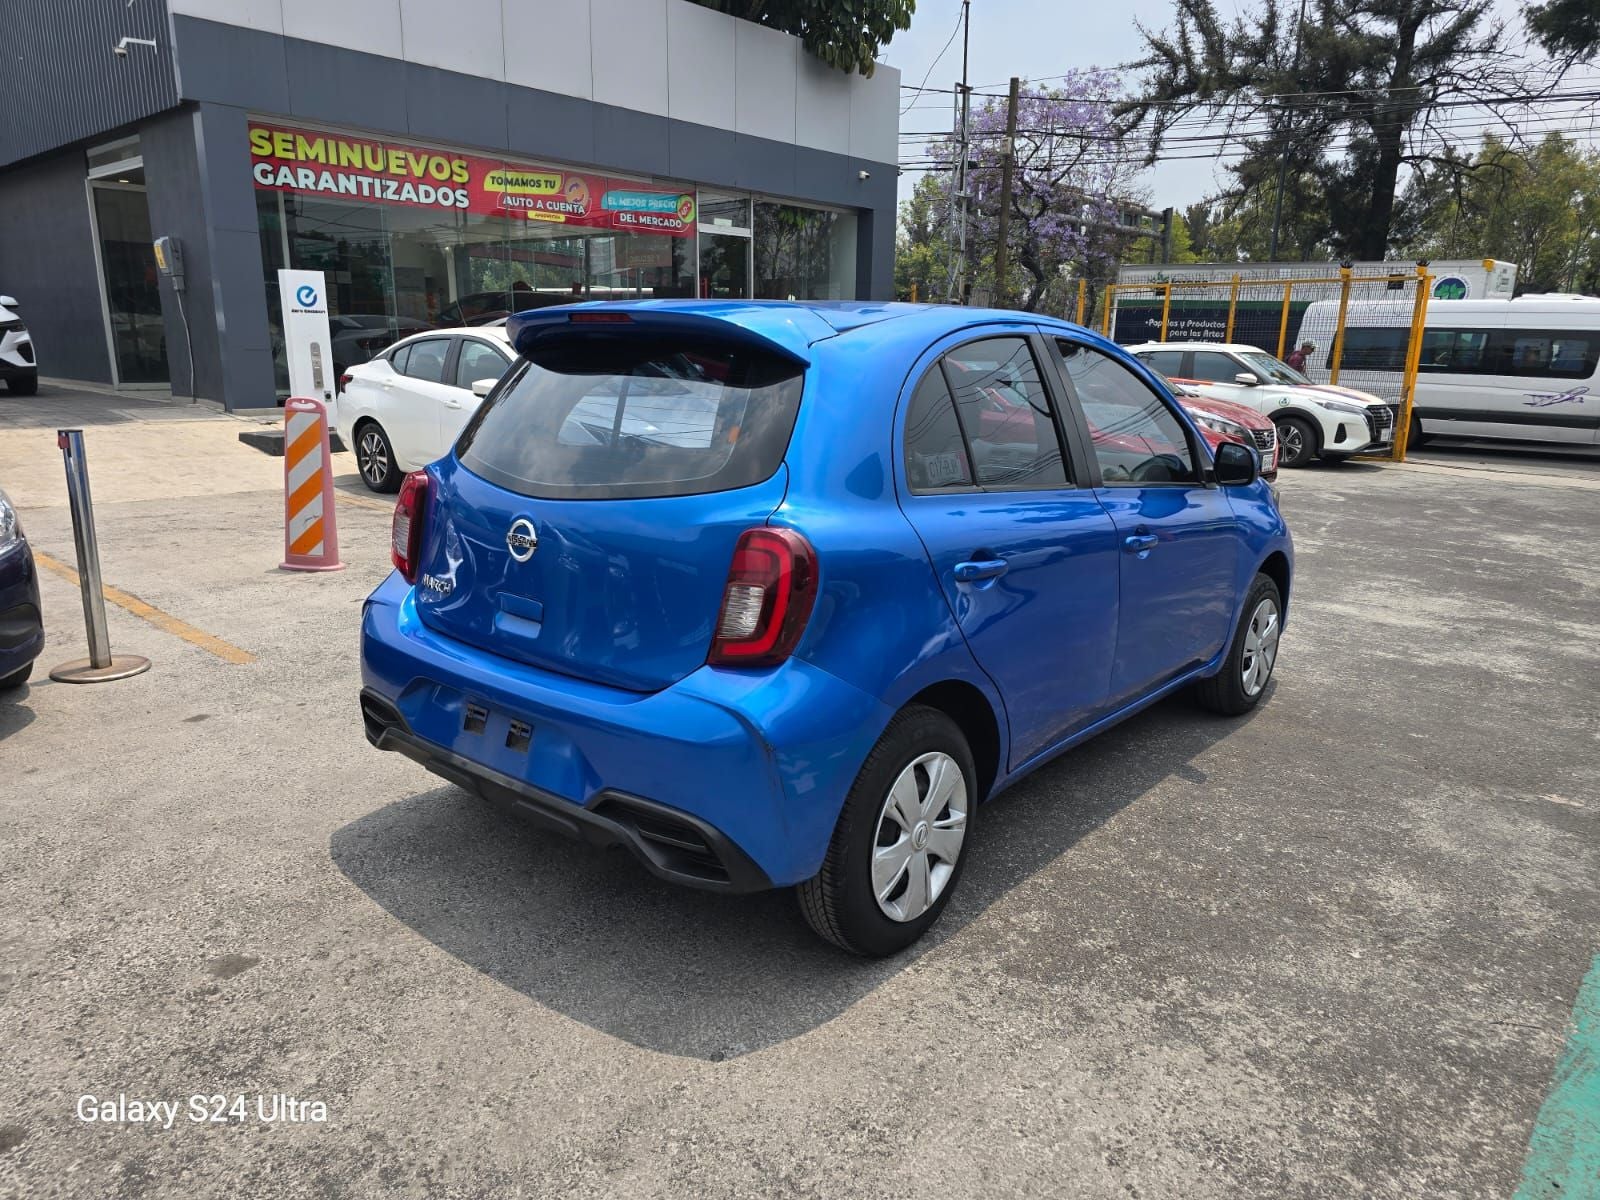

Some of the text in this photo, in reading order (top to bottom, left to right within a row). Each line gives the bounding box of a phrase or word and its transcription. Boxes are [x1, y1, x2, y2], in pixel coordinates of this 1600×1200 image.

[250, 128, 470, 183] SEMINUEVOS
[253, 162, 470, 208] GARANTIZADOS
[490, 175, 556, 189] TOMAMOS TU
[503, 195, 586, 215] AUTO A CUENTA
[620, 213, 682, 228] DEL MERCADO
[1187, 319, 1226, 328] Productos
[1190, 329, 1201, 337] las
[1203, 329, 1225, 338] Artes
[422, 573, 451, 593] MARCH
